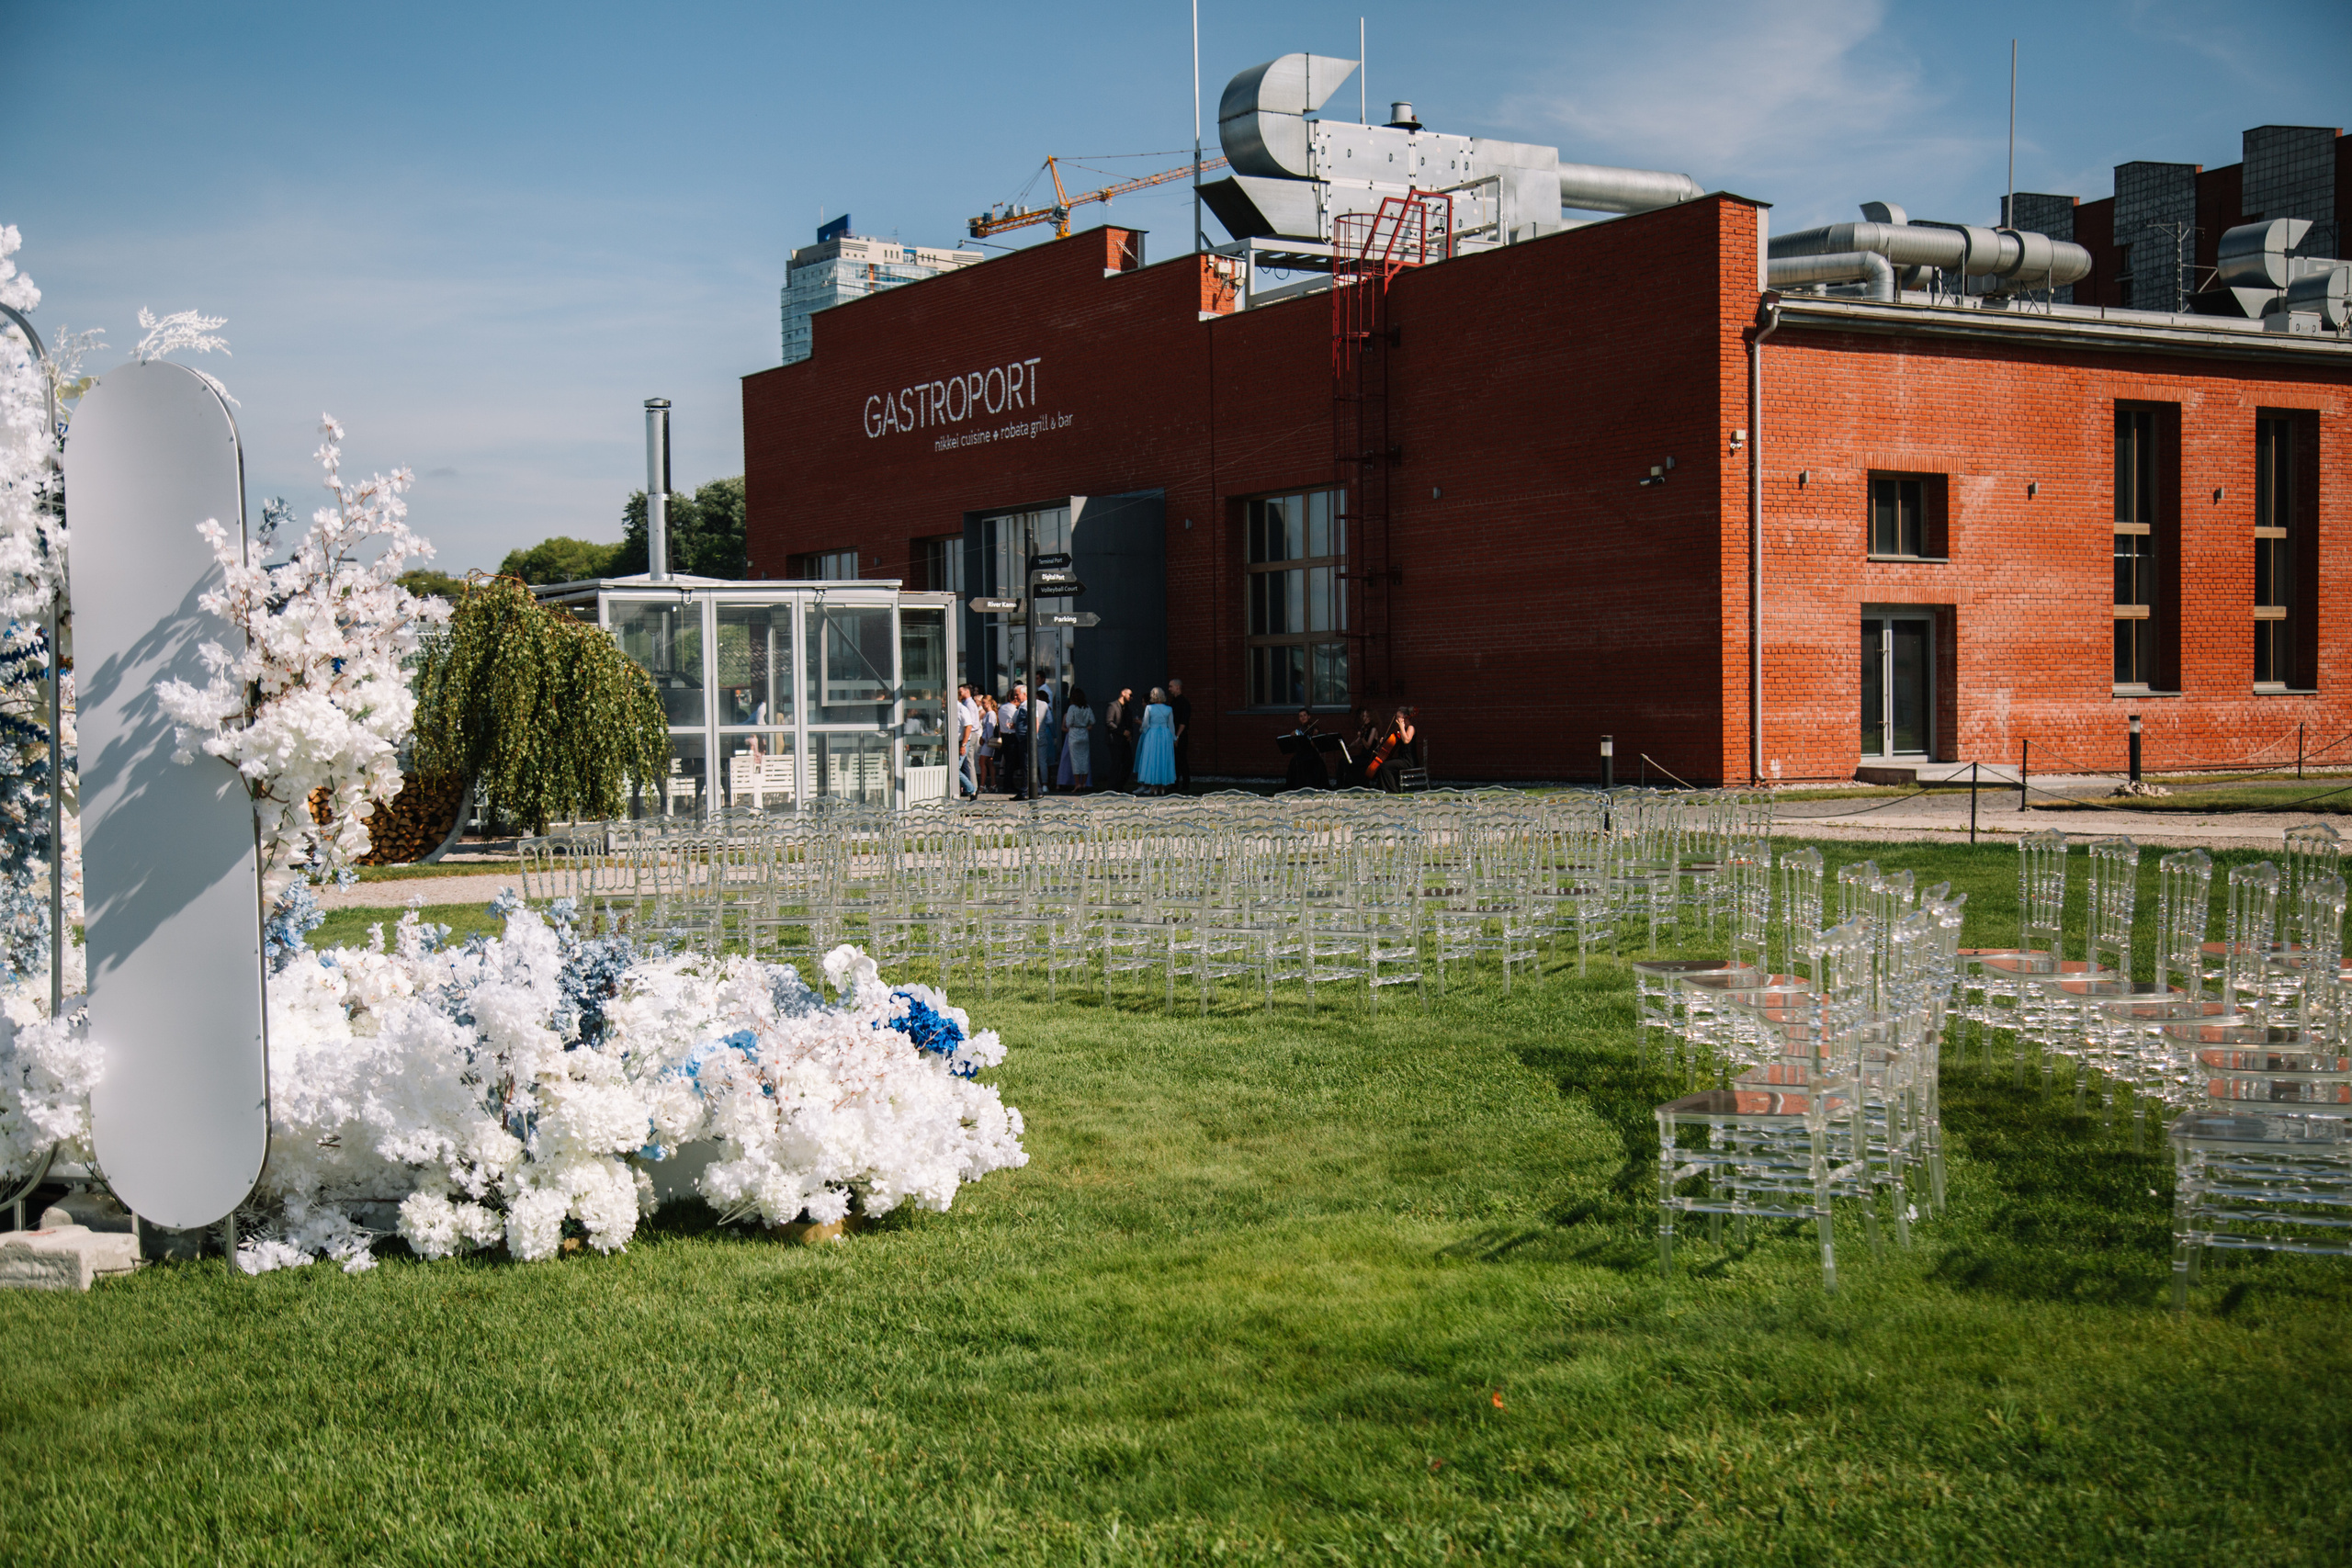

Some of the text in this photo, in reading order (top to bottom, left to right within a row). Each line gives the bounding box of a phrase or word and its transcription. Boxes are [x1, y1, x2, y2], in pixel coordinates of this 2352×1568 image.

[864, 356, 1042, 439] GASTROPORT
[934, 433, 959, 452] nikkei
[960, 428, 991, 446] cuisine
[1001, 421, 1029, 440] robata
[1030, 413, 1049, 439] grill
[1050, 417, 1057, 430] &
[1057, 411, 1074, 428] bar
[1042, 573, 1056, 581] Digital
[1054, 615, 1078, 624] Parking
